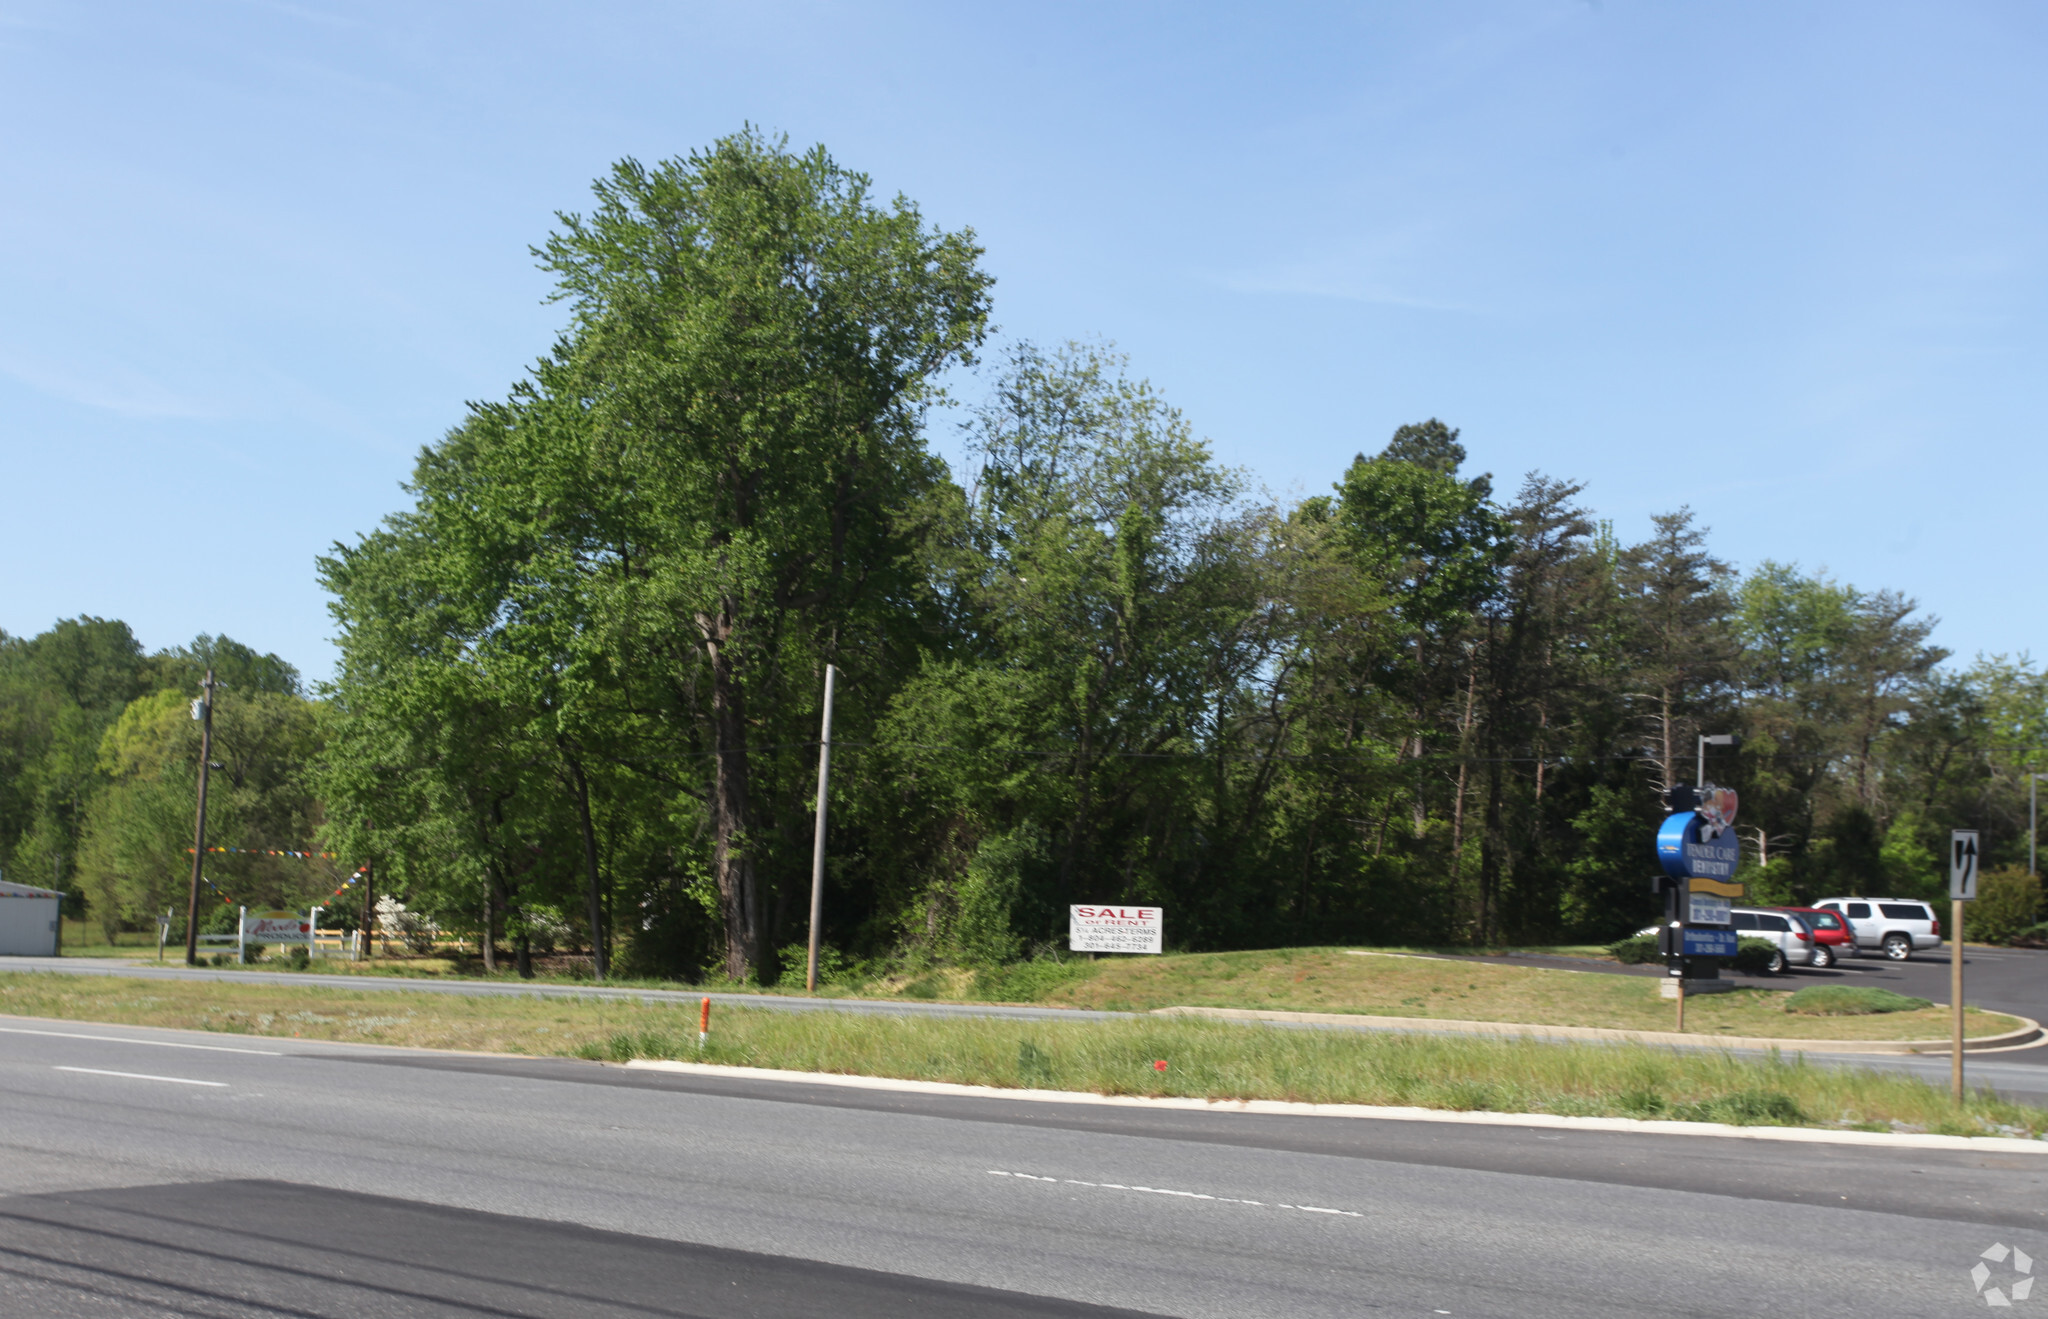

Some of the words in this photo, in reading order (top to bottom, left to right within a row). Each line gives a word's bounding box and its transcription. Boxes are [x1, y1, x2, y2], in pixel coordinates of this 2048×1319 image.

[1686, 843, 1715, 858] TENDER
[1716, 846, 1736, 861] CARE
[1078, 907, 1155, 920] SALE
